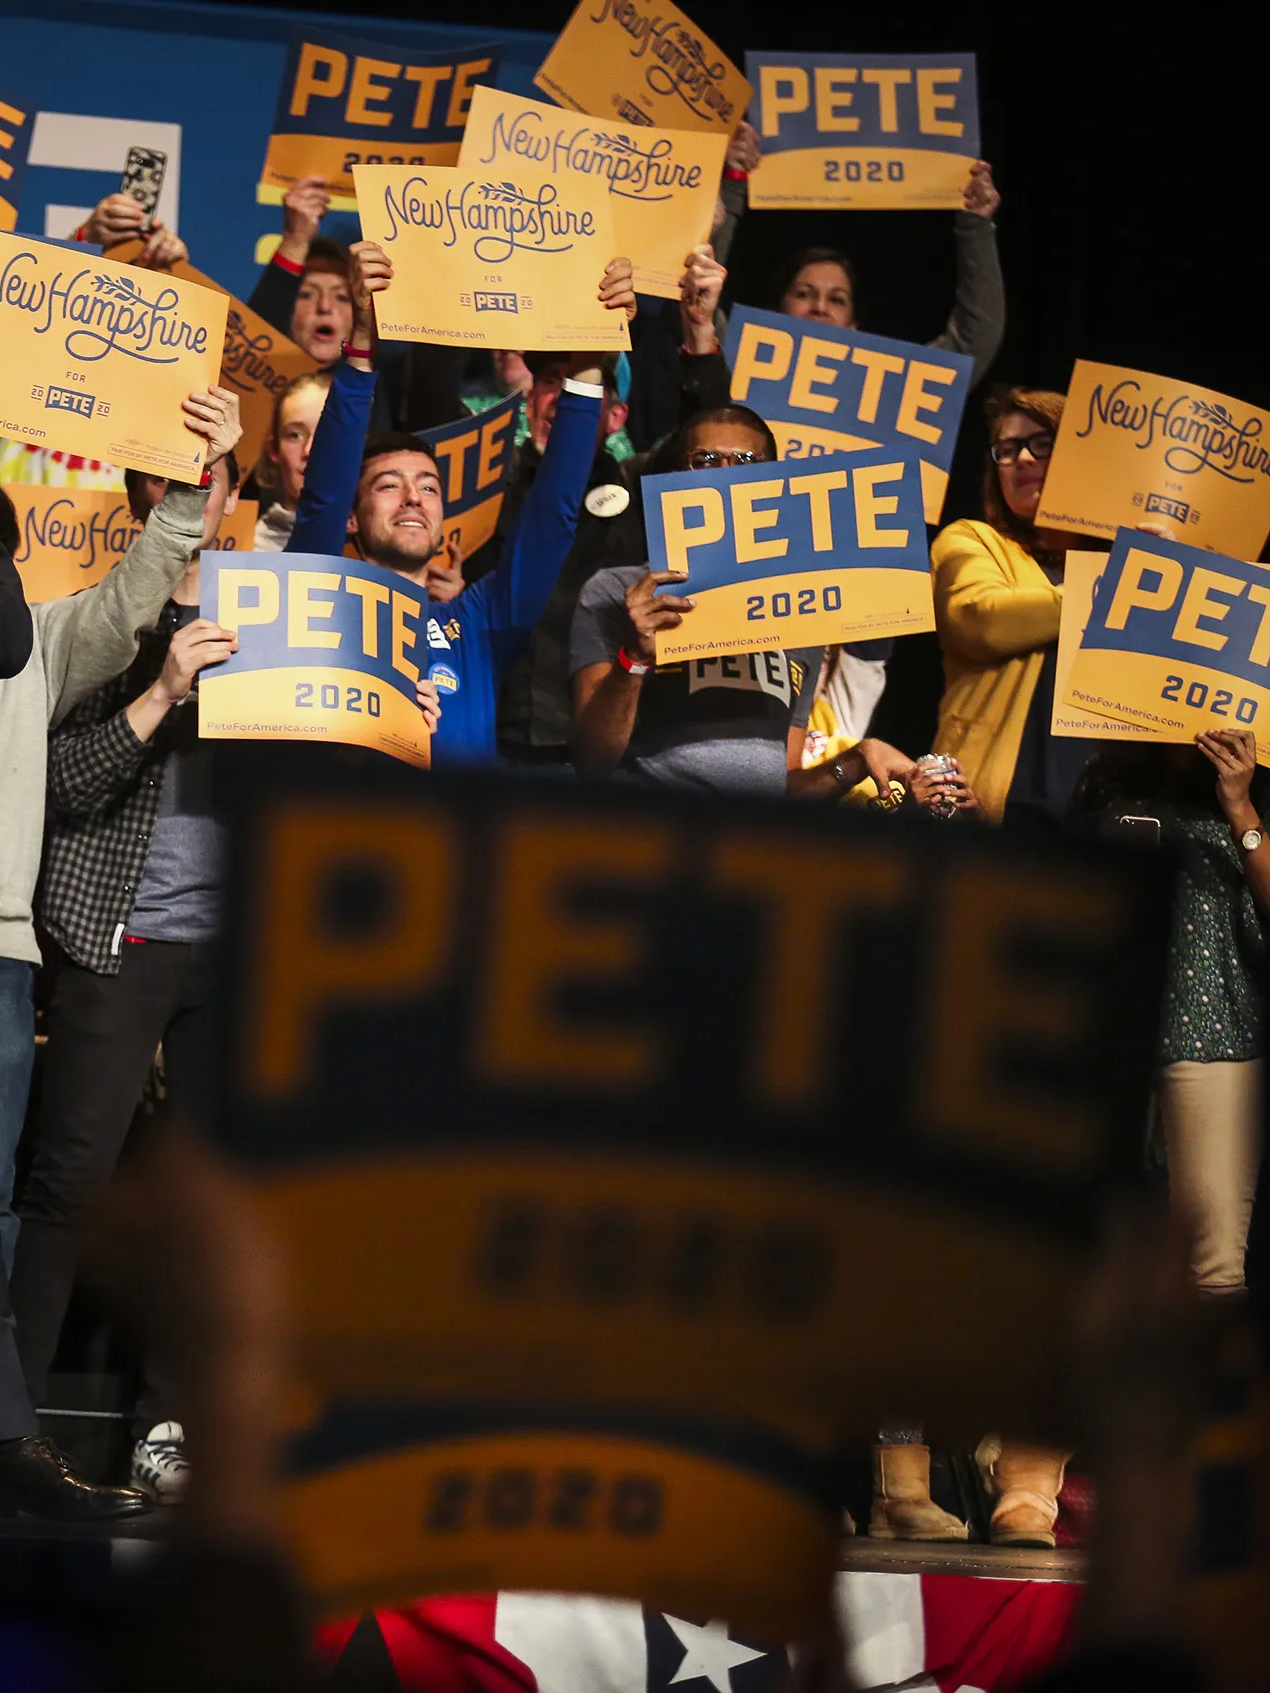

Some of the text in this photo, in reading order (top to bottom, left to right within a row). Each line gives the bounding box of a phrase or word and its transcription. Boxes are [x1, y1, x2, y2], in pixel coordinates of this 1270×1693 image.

[289, 42, 493, 129] PETE
[759, 66, 964, 138] PETE
[824, 161, 904, 182] 2020
[384, 176, 595, 263] New Hampshire
[477, 294, 517, 312] PETE
[484, 274, 503, 283] FOR
[34, 269, 207, 364] Hampshire
[381, 322, 486, 340] PeteForAmerica.com
[31, 387, 110, 414] 20 PETE 20
[66, 370, 86, 382] FOR
[730, 322, 958, 445] PETE
[435, 409, 514, 503] TE
[1076, 380, 1270, 483] New Hampshir
[660, 462, 910, 573] PETE
[1148, 496, 1188, 520] PETE
[218, 569, 422, 685] PETE
[747, 585, 842, 621] 2020
[1104, 547, 1270, 667] PET
[664, 634, 781, 655] PeteForAmerica.com
[295, 683, 380, 718] 2020
[1072, 689, 1185, 729] PeteForAmerica.com
[1161, 675, 1258, 724] 2020
[207, 721, 328, 734] PeteForAmerica.com
[250, 806, 1122, 1165] PETE
[427, 1470, 665, 1536] 2020
